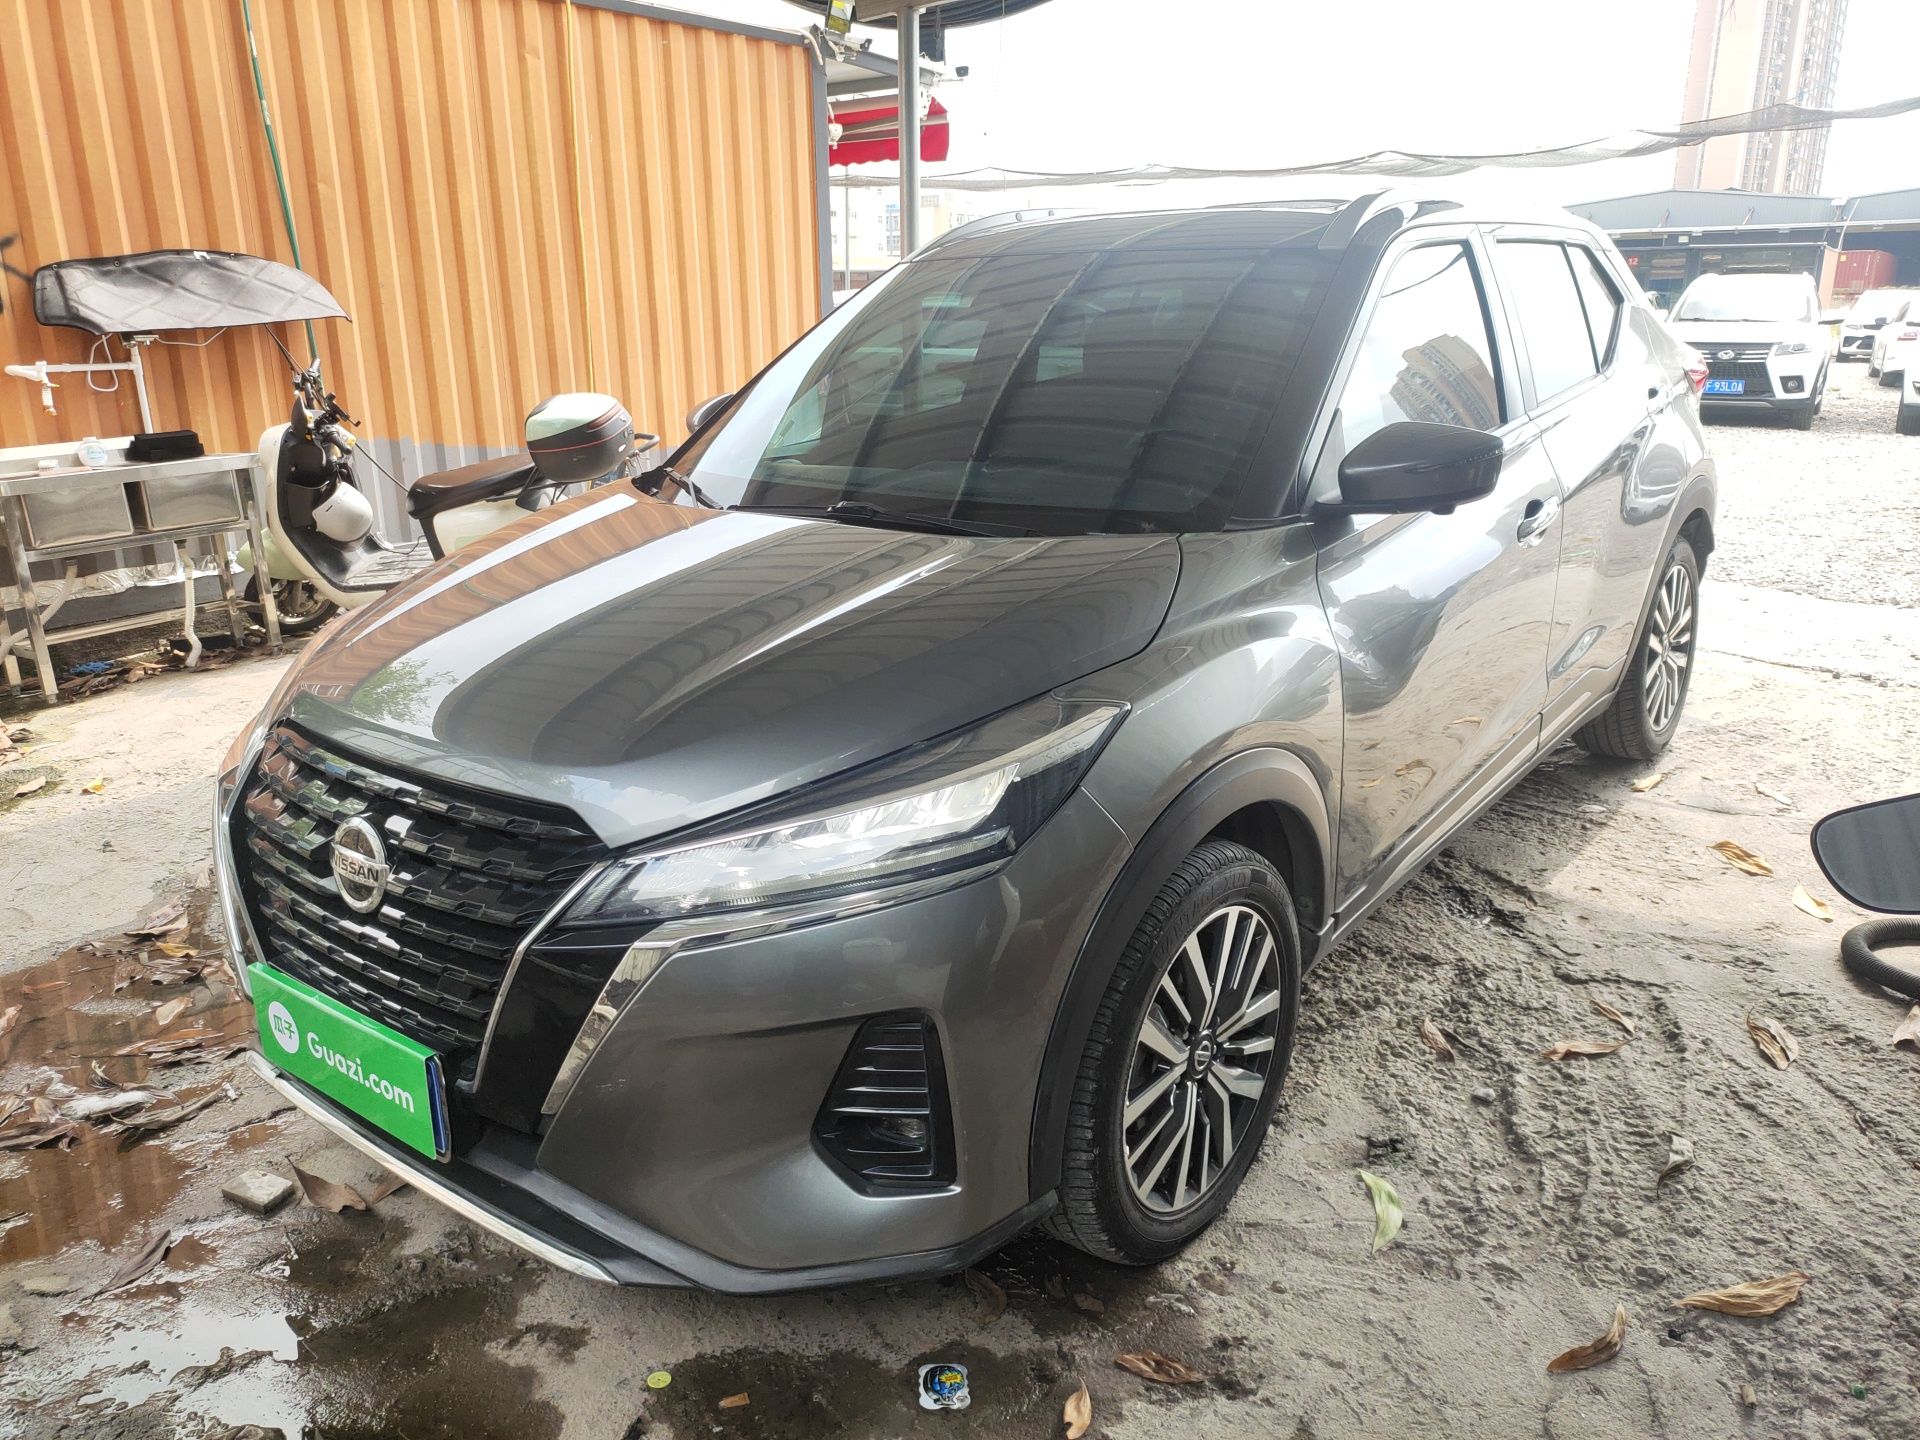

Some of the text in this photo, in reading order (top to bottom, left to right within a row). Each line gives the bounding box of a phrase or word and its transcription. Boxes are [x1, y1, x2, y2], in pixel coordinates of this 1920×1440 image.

[333, 852, 379, 882] NISSAN
[272, 1013, 295, 1041] 瓜子
[307, 1031, 415, 1113] Guazi.com
